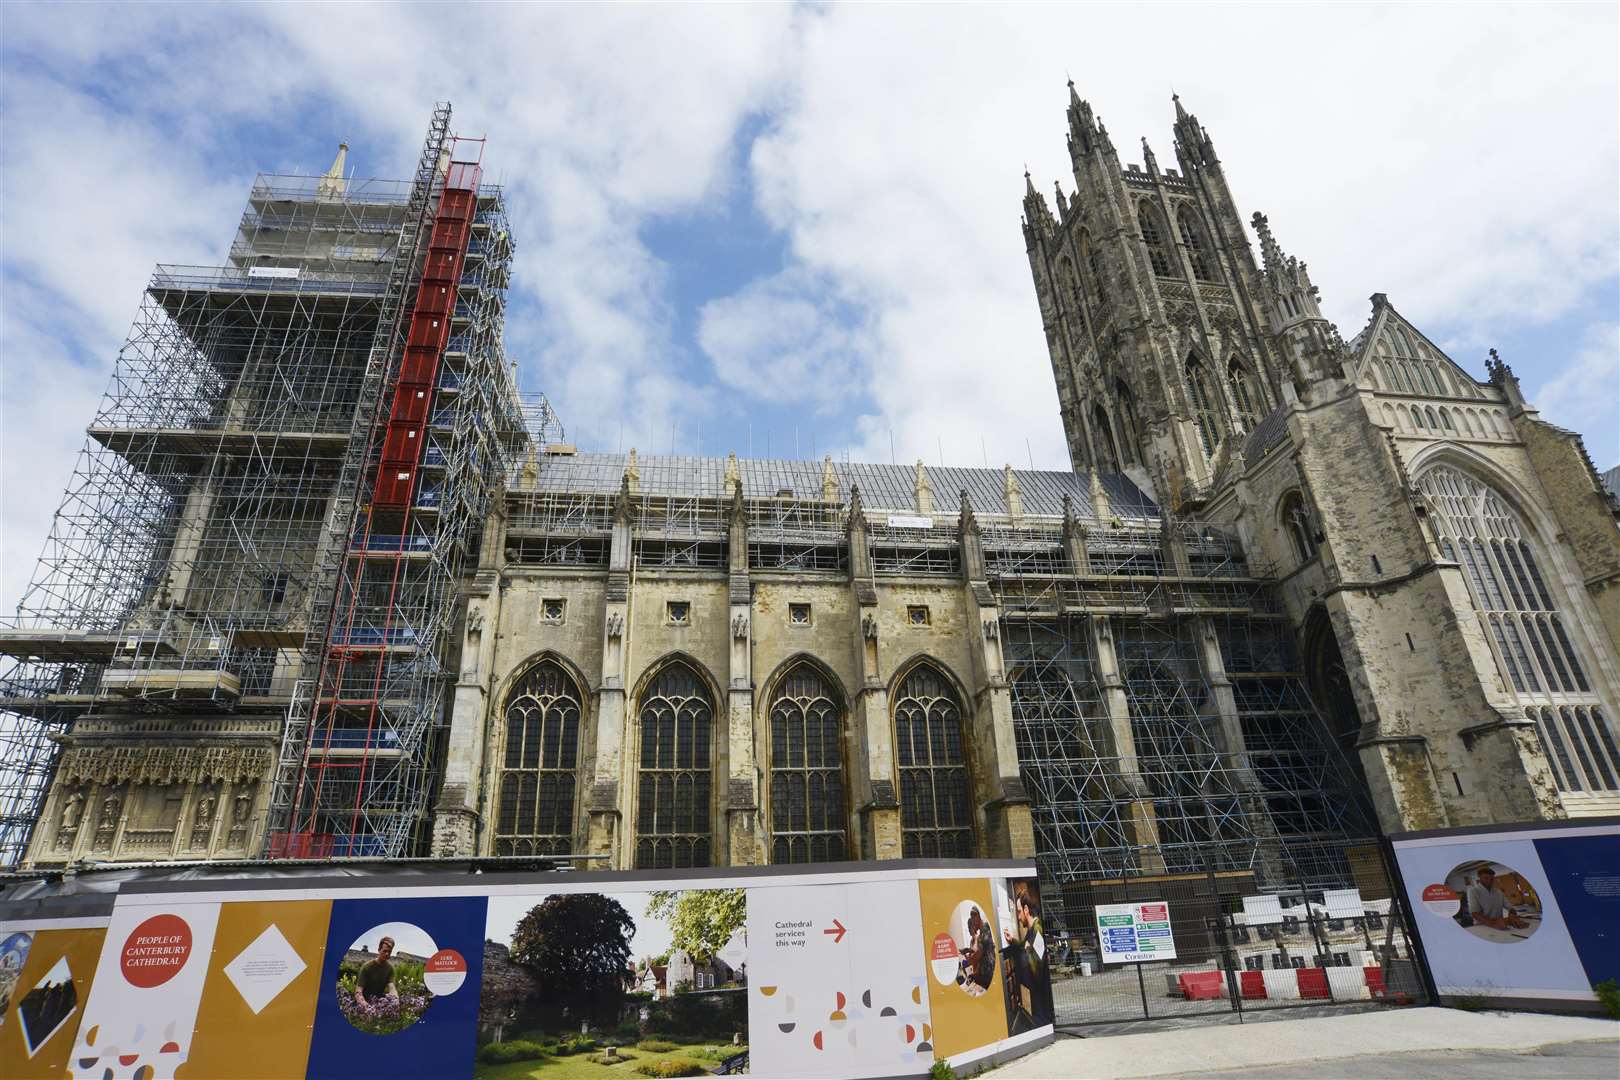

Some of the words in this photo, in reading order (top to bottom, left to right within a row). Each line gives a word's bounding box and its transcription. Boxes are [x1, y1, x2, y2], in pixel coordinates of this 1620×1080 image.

[775, 920, 812, 929] Cathedral
[775, 929, 805, 937] services
[136, 936, 169, 945] PEOPLE
[169, 935, 183, 944] OF
[776, 939, 789, 947] this
[791, 939, 806, 948] way
[126, 946, 186, 956] CANTERBURY
[126, 957, 180, 967] CATHEDRAL
